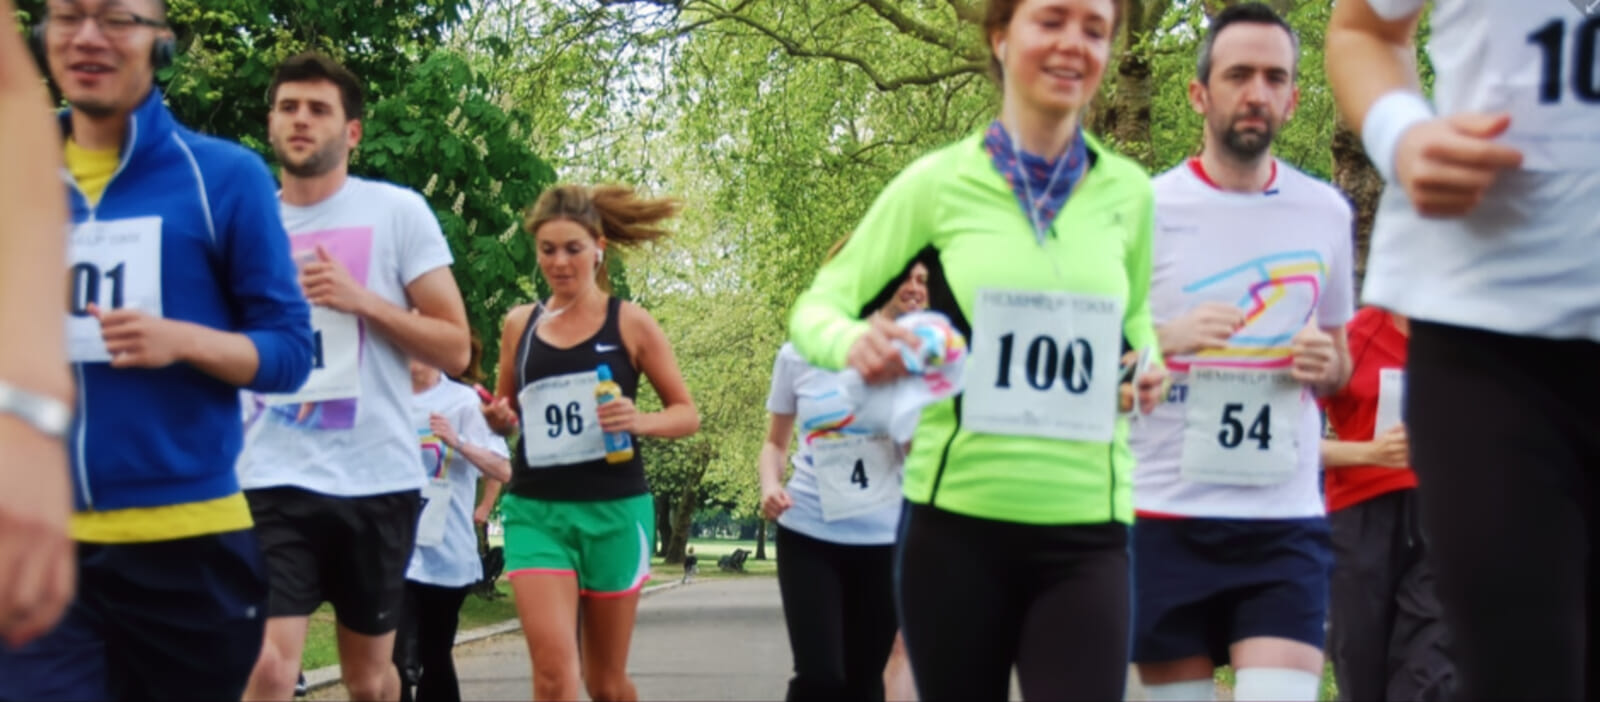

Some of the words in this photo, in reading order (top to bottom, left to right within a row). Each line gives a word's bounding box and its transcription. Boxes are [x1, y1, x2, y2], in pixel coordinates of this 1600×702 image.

[994, 333, 1093, 395] 100
[545, 401, 583, 438] 96
[1218, 403, 1272, 450] 54
[850, 458, 869, 489] 4
